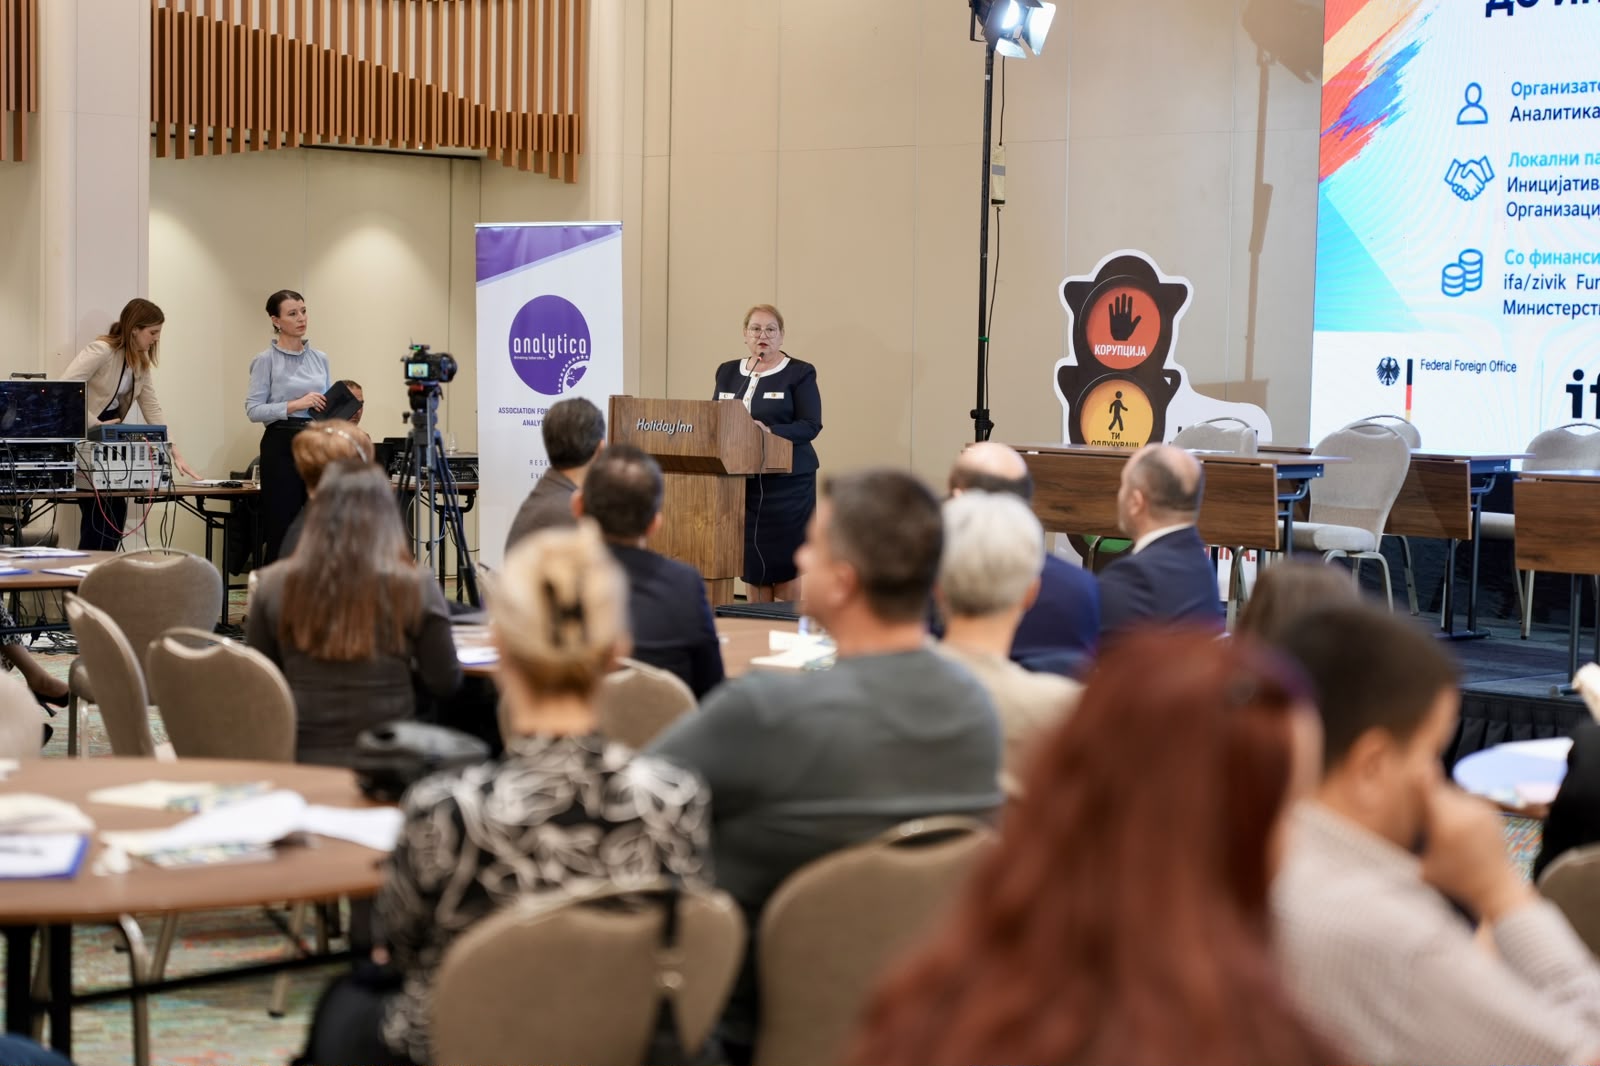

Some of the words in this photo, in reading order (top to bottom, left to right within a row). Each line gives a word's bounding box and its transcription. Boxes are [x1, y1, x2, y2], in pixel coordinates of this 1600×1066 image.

[1510, 105, 1600, 122] Аналитика
[1508, 152, 1579, 167] Локални
[1504, 249, 1524, 265] Со
[1504, 273, 1566, 291] ifa/zivik
[1503, 299, 1600, 320] Министерст
[514, 333, 586, 359] analytica
[1094, 344, 1147, 357] КОРУПЦИЈА
[1420, 359, 1451, 371] Federal
[1454, 359, 1486, 374] Foreign
[1489, 360, 1517, 373] Office
[636, 418, 676, 435] Holiday
[676, 419, 694, 433] Inn
[1111, 432, 1121, 440] ТИ
